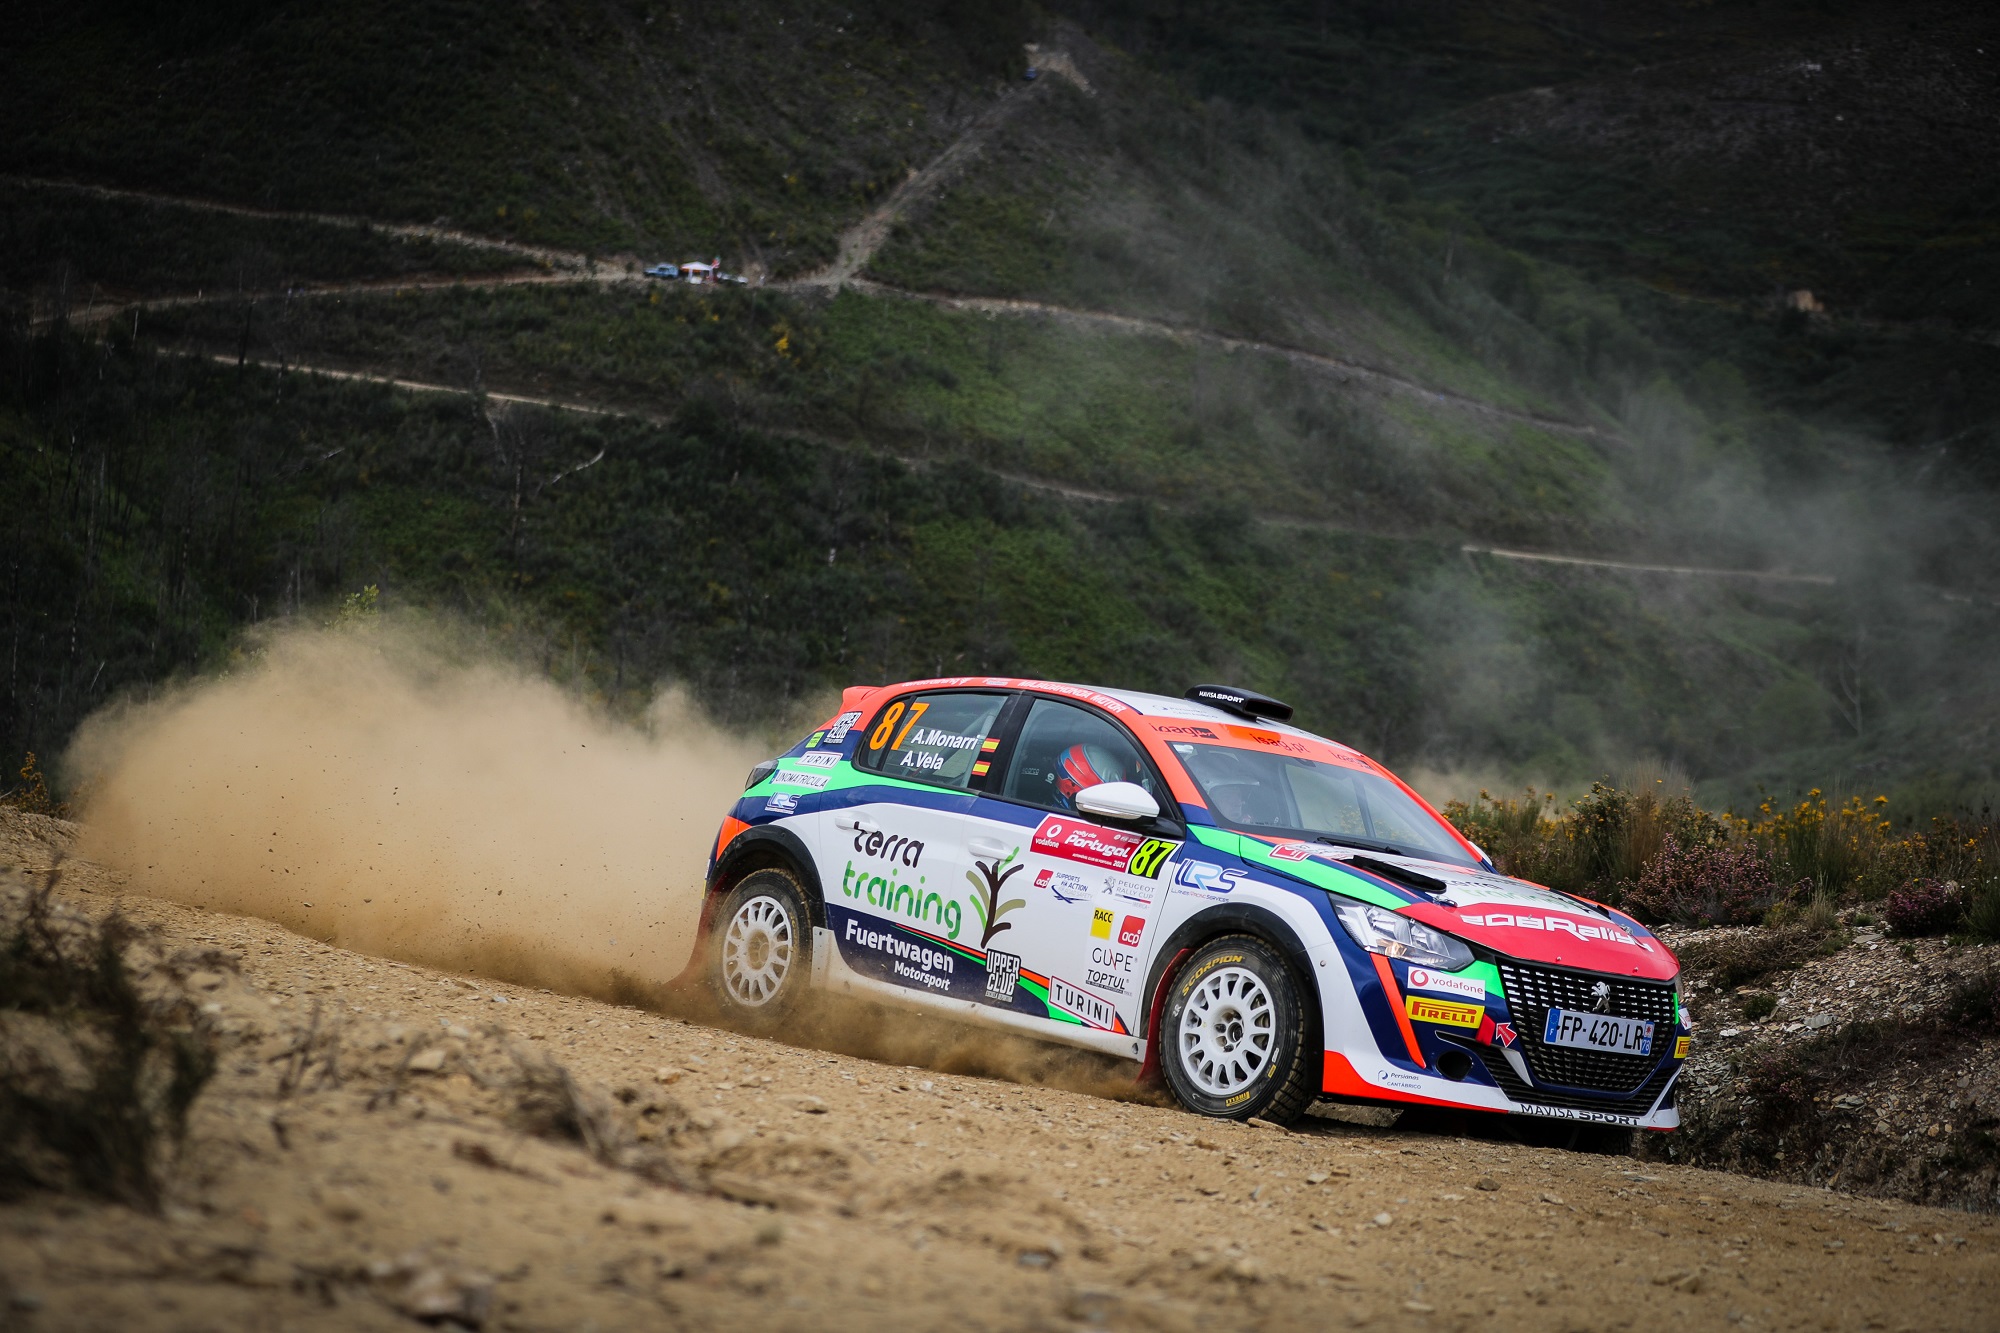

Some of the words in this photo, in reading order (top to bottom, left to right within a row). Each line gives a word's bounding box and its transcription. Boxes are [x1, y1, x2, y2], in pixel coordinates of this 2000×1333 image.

[1090, 693, 1127, 713] MOTOR
[1199, 690, 1217, 699] MAVISA
[1217, 693, 1244, 704] SPORT
[869, 701, 930, 751] 87
[911, 729, 981, 750] A.Monarri
[801, 754, 837, 766] TURINI
[900, 750, 945, 770] A.Vela
[853, 821, 925, 868] terra
[1035, 837, 1060, 849] vodafone
[1064, 834, 1132, 858] Portugal
[1112, 860, 1126, 869] 2021
[1130, 839, 1177, 878] 87
[1056, 872, 1081, 883] SUPPORTS
[1067, 882, 1089, 892] ACTION
[1118, 879, 1155, 893] PEUGEOT
[842, 860, 962, 940] training
[1116, 887, 1138, 896] RALLY
[1138, 891, 1154, 900] CUP
[1093, 909, 1113, 923] RACC
[845, 919, 954, 974] Fuertwagen
[1122, 930, 1141, 945] acp
[986, 950, 1020, 980] UPPER
[894, 960, 951, 991] Motorsport
[986, 972, 1016, 996] CLUB
[1087, 969, 1126, 990] TOPTUL
[1182, 955, 1243, 996] SCORPION
[1431, 977, 1484, 995] vodafone
[1055, 984, 1110, 1024] TURINI
[1411, 1001, 1477, 1024] PIRELLI
[1549, 1028, 1554, 1036] F
[1390, 1072, 1419, 1081] Persianas
[1520, 1103, 1575, 1119] MAVISA
[1578, 1110, 1641, 1126] SPORT
